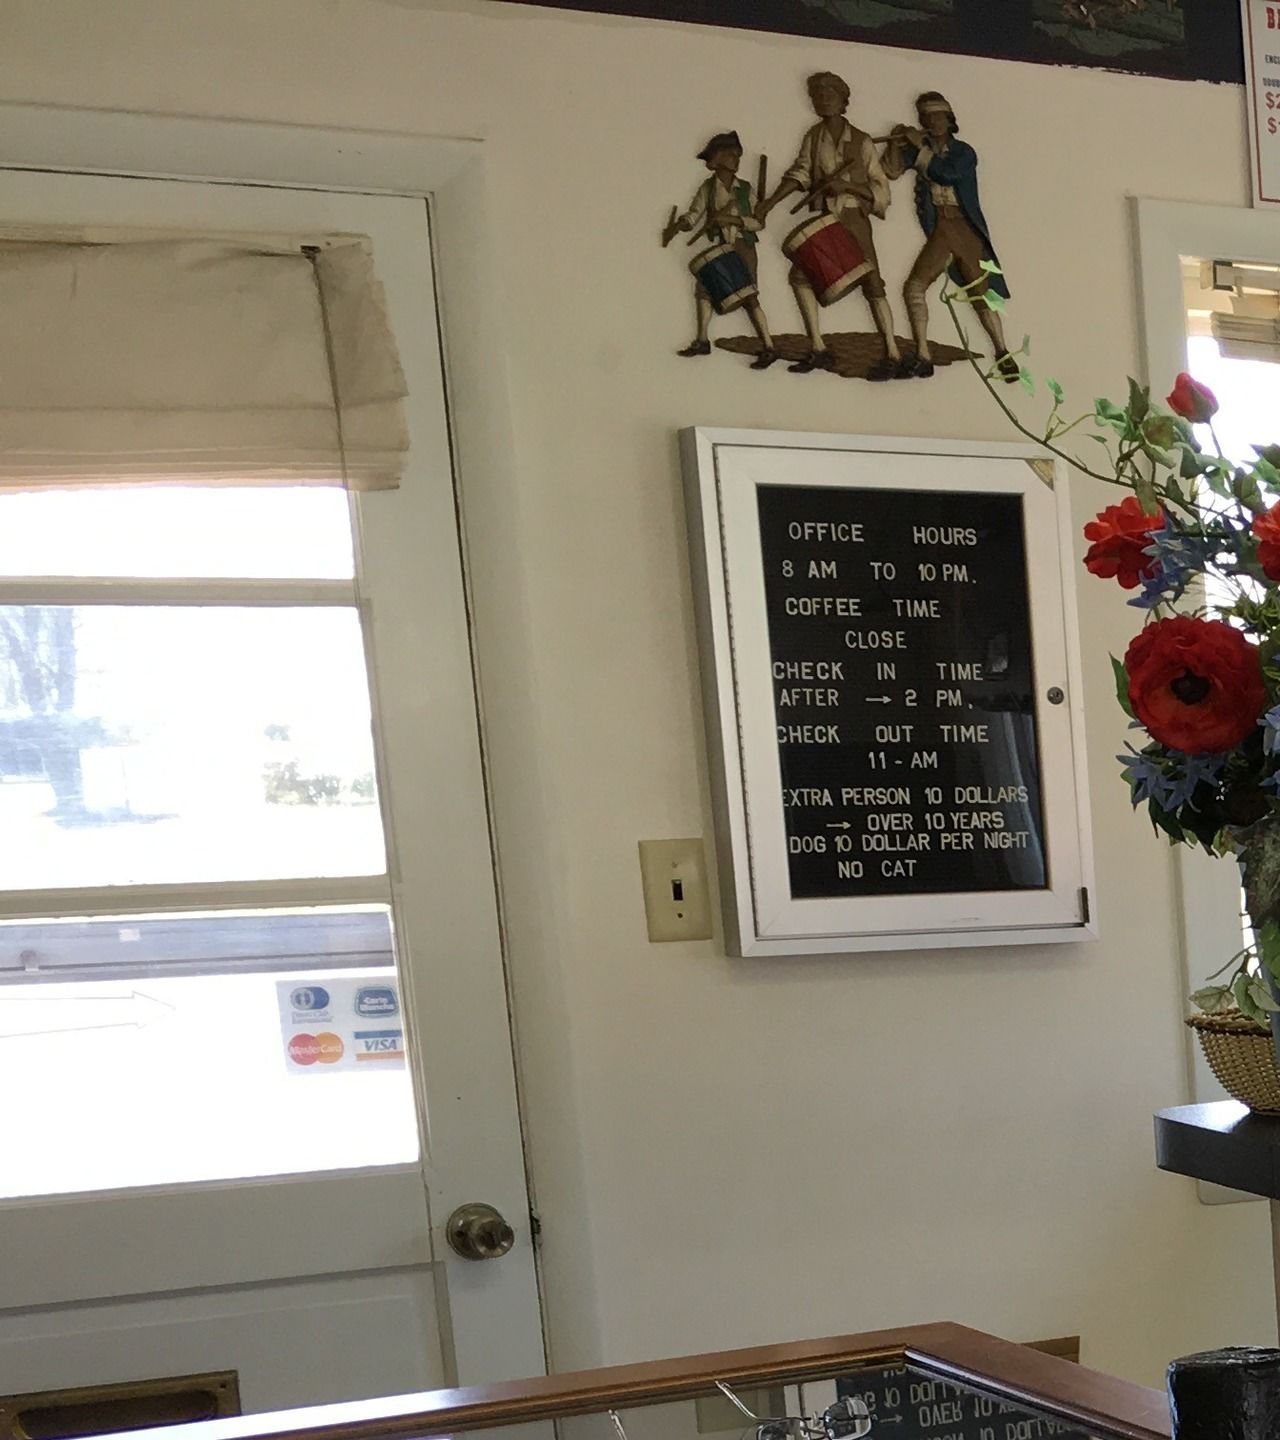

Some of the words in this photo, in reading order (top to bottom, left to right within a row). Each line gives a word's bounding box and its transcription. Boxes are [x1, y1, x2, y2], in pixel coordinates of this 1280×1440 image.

[788, 521, 865, 543] OFFICE
[913, 525, 978, 546] HOURS
[782, 559, 794, 578] 8
[807, 560, 838, 580] AM
[870, 561, 896, 581] TO
[918, 563, 937, 582] 10
[942, 564, 977, 584] PM.
[785, 597, 862, 617] COFFEE
[892, 599, 941, 618] TIME
[845, 630, 907, 650] CLOSE
[773, 661, 845, 681] CHECK
[876, 662, 896, 681] IN
[936, 662, 984, 681] TIME
[779, 688, 839, 706] AFTER
[904, 689, 918, 707] 2
[776, 725, 841, 744] CHECK
[875, 725, 914, 743] OUT
[939, 724, 989, 743] TIME
[868, 751, 887, 770] 11
[910, 751, 938, 769] AM
[782, 788, 833, 807] EXTRA
[842, 787, 910, 806] PERSON
[924, 787, 942, 805] 10
[954, 786, 1029, 805] DOLLARS
[867, 812, 913, 831] OVER
[924, 812, 945, 831] 10
[950, 811, 1005, 829] YEARS
[789, 835, 826, 854] DOG
[834, 834, 852, 853] 10
[862, 832, 930, 851] DOLLAR
[940, 832, 974, 850] PER
[983, 831, 1029, 849] NIGHT
[838, 861, 864, 879] NO
[881, 859, 917, 877] CAT
[364, 1039, 398, 1051] VISA
